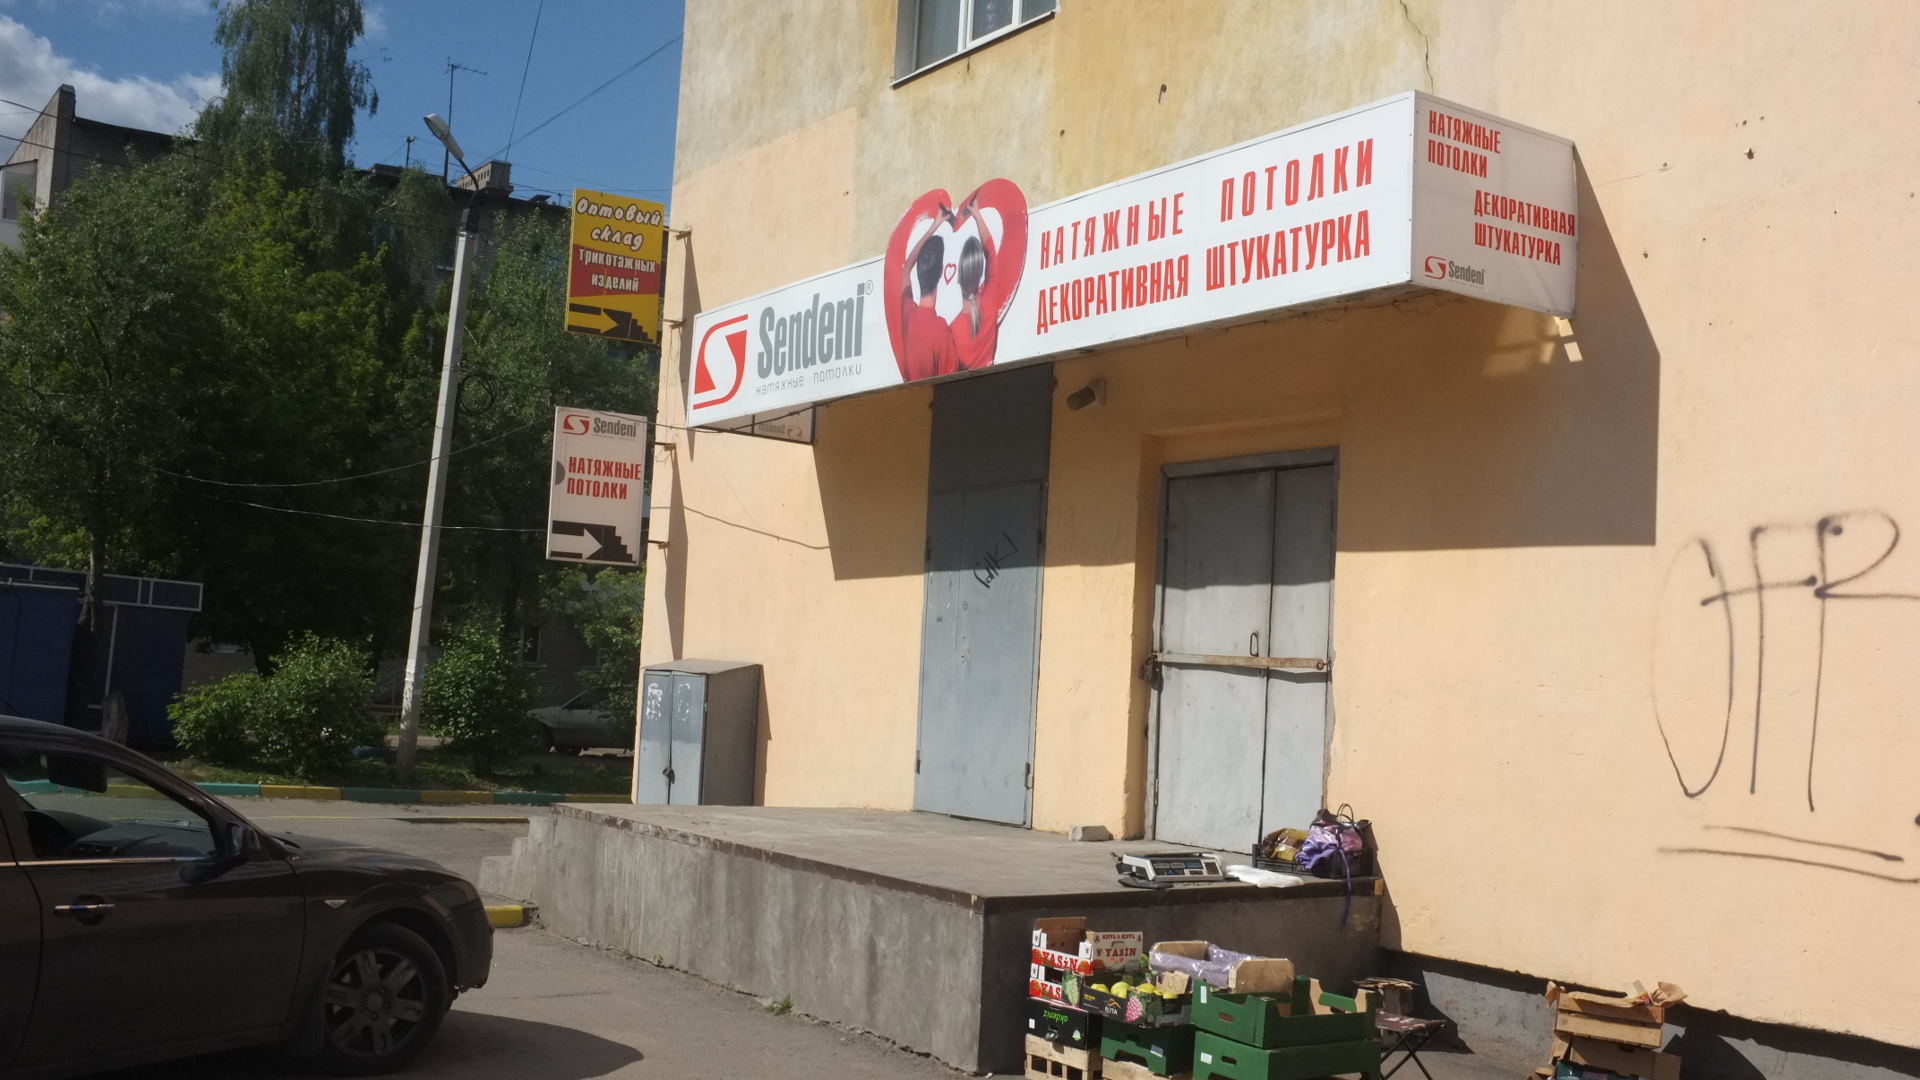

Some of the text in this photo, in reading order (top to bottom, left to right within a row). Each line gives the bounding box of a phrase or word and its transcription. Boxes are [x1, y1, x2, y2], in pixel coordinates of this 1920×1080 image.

[1429, 110, 1501, 154] НАТЯЖНЫЕ
[1428, 139, 1488, 179] ПОТОЛКИ
[576, 197, 662, 227] Оптовый
[1040, 138, 1373, 270] НАТЯЖНЫЕ ПОТОЛКИ
[1474, 189, 1576, 237] ДЕКОРАТИВНАЯ
[590, 225, 644, 251] склад
[1474, 222, 1561, 266] ШТУКАТУРКА
[579, 248, 656, 273] трикотажных
[1036, 209, 1370, 335] ДЕКОРАТИВНАЯ ШТУКАТУРКА
[1448, 260, 1485, 286] Sendeni
[591, 274, 639, 292] изделий
[755, 363, 862, 397] натяжные потолки
[593, 417, 637, 438] Sendeni
[568, 456, 642, 480] НАТЯЖНЫЕ
[566, 477, 628, 500] ПОТОЛКИ
